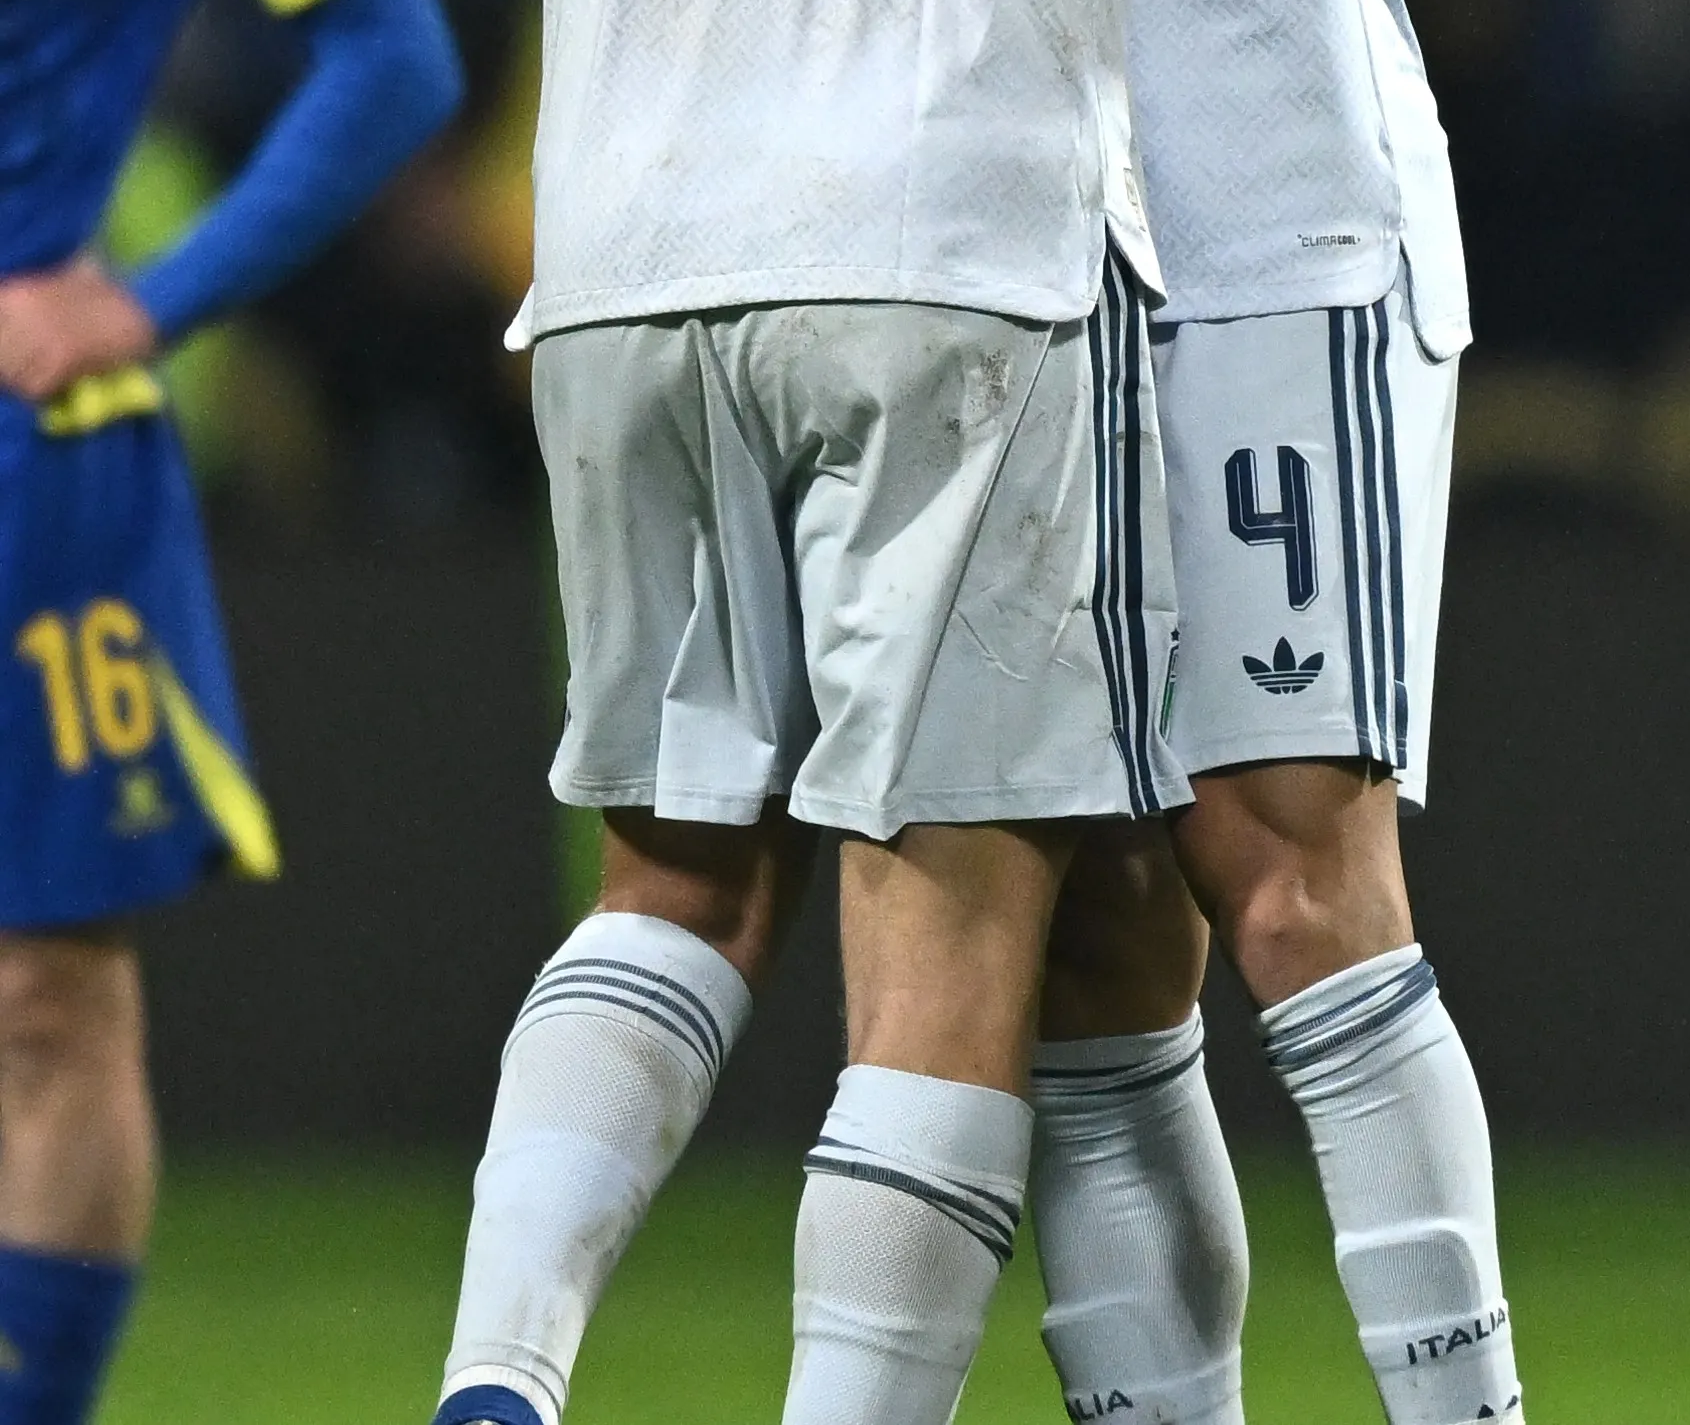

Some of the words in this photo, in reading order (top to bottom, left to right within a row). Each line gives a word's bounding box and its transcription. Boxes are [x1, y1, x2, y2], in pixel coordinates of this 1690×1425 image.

[1225, 445, 1319, 611] 4
[16, 598, 154, 773] 16
[1406, 1307, 1506, 1365] ITALIA
[1066, 1389, 1134, 1421] LIA
